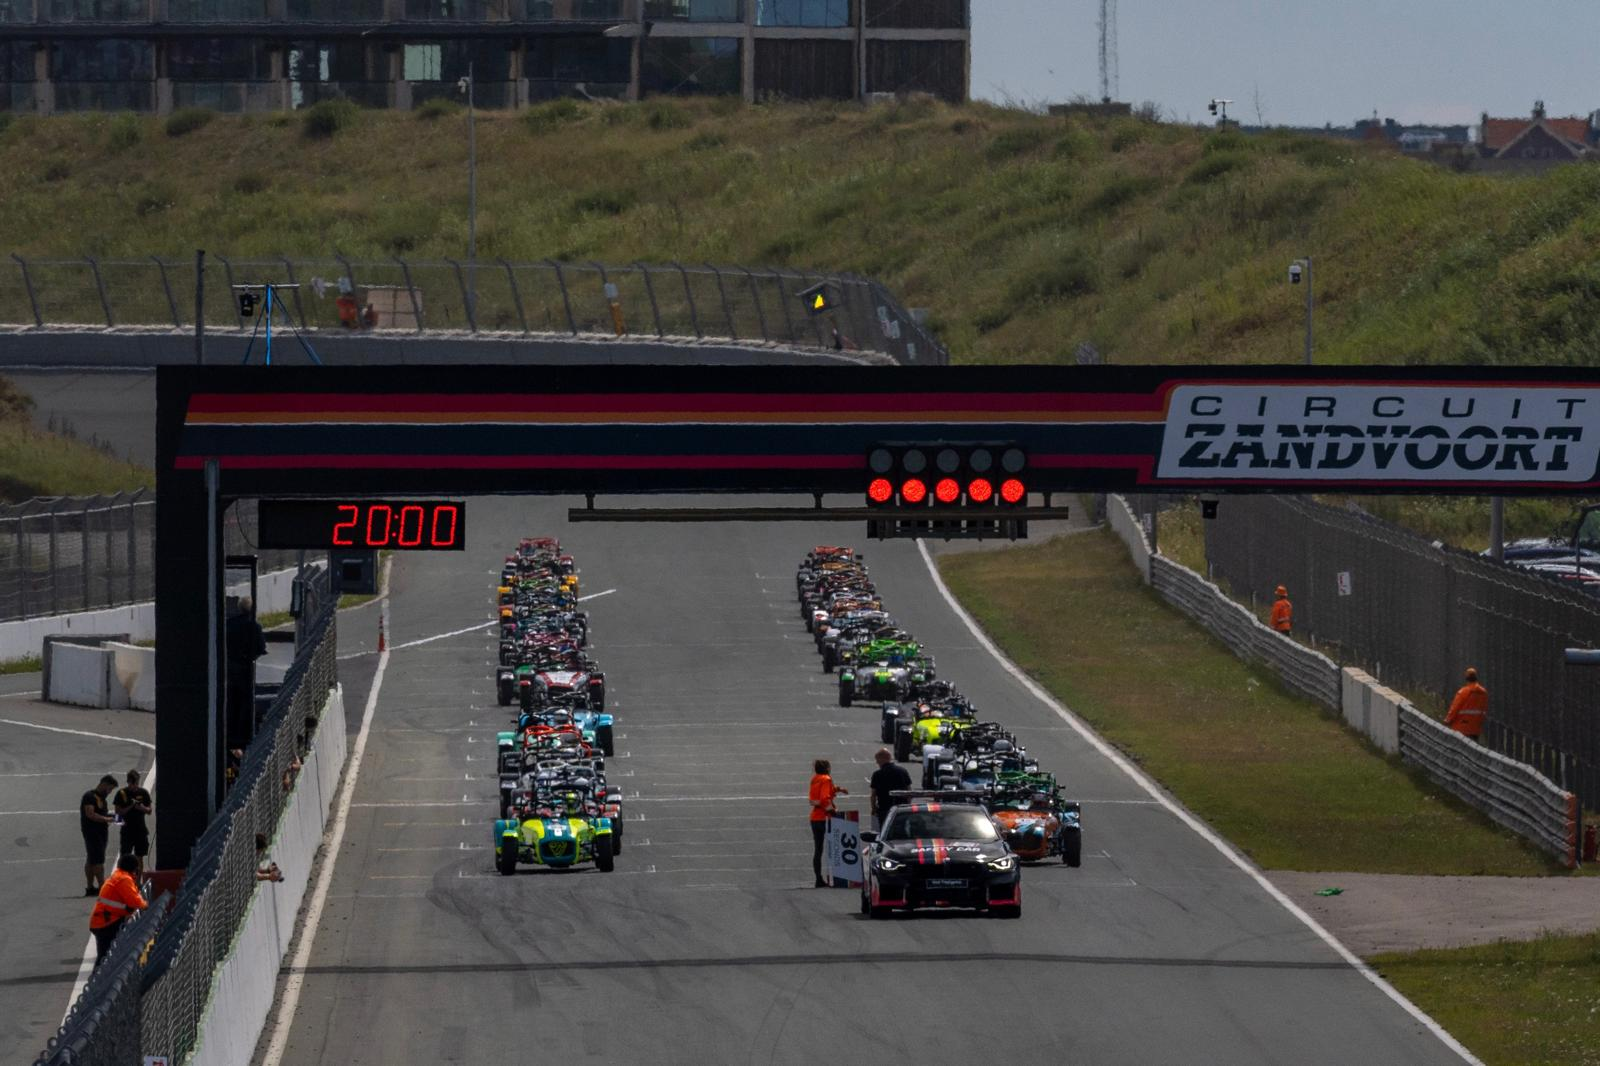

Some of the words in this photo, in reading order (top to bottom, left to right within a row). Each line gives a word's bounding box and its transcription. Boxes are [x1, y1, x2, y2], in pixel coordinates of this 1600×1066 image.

[1190, 396, 1587, 420] CIRCUIT
[1178, 424, 1584, 471] ZANDVOORT
[333, 505, 458, 546] 20:00
[841, 832, 859, 865] 30
